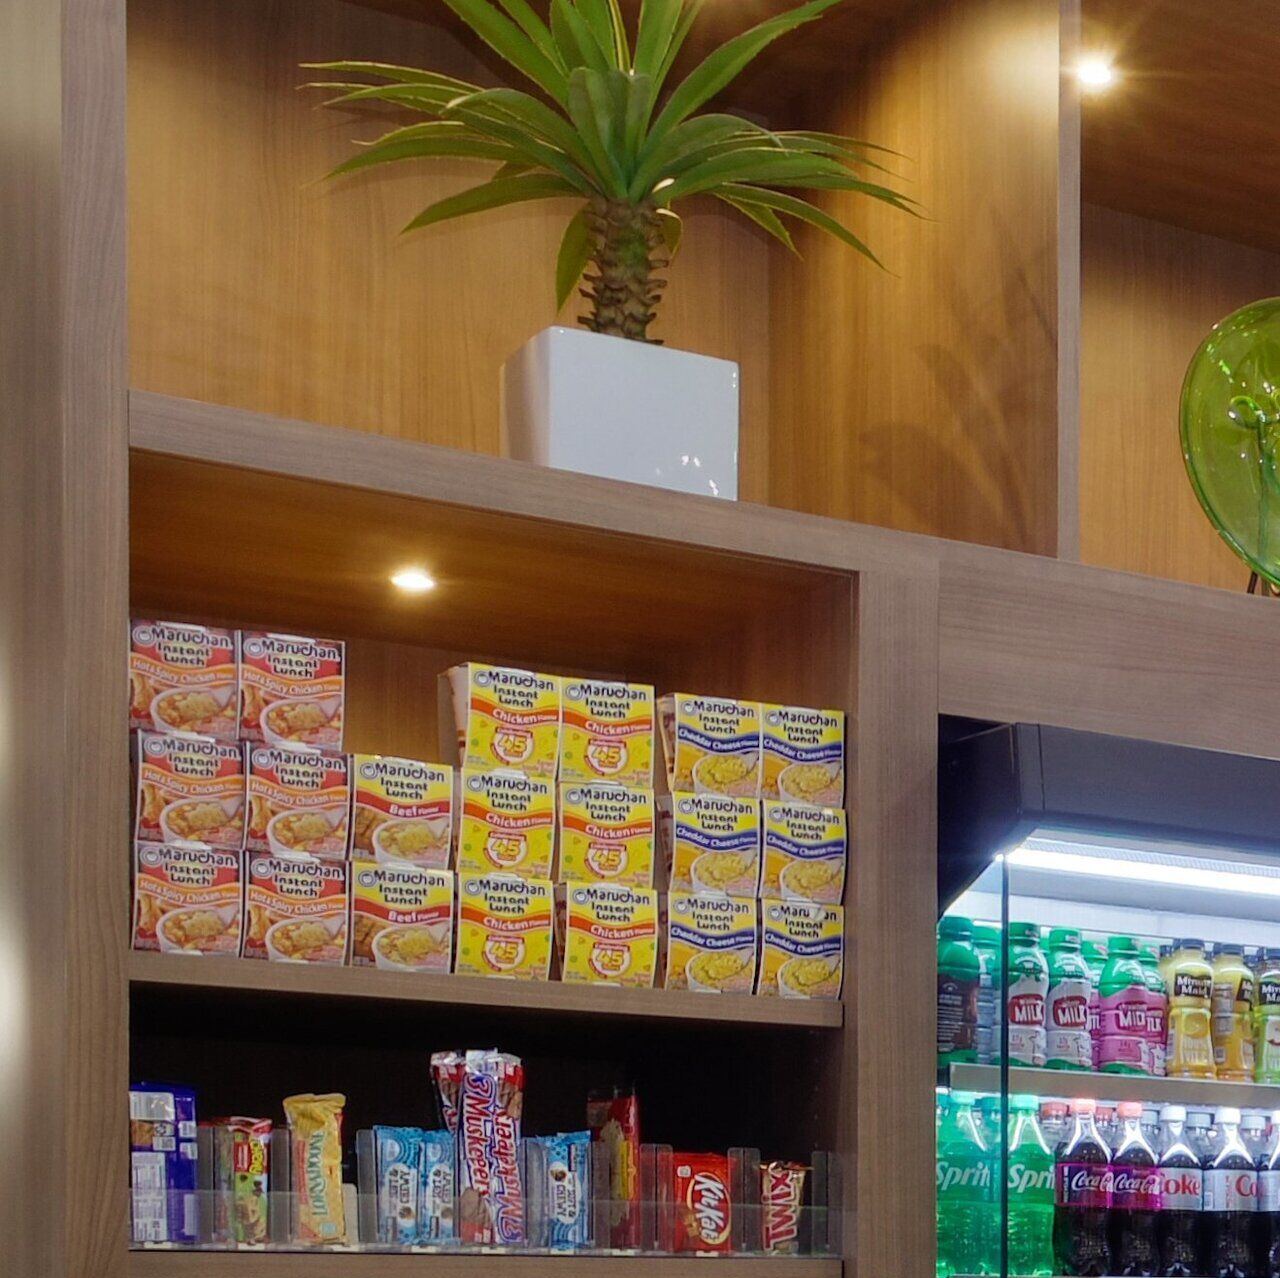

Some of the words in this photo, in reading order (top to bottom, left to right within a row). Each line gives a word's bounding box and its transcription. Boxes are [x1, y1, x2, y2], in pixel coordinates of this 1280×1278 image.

[152, 627, 229, 648] Maruchan
[158, 644, 209, 657] Instant
[262, 640, 337, 659] Maruchan
[164, 653, 205, 666] Lunch
[267, 655, 317, 668] Instant
[274, 665, 312, 678] Lunch
[489, 671, 554, 690] Maruchan
[494, 685, 538, 699] Instant
[581, 684, 646, 700] Maruchan
[499, 696, 533, 708] Lunch
[586, 698, 630, 709] Instant
[591, 709, 625, 718] Lunch
[694, 701, 754, 717] Maruchan
[493, 709, 536, 724] Chicken
[699, 714, 739, 725] Instant
[779, 712, 837, 727] Maruchan
[586, 721, 630, 734] Chicken
[704, 724, 736, 734] Lunch
[784, 723, 823, 735] Instant
[788, 733, 819, 744] Lunch
[162, 739, 237, 758] Maruchan
[169, 754, 219, 768] Instant
[270, 752, 342, 770] Maruchan
[175, 764, 214, 777] Lunch
[276, 765, 324, 778] Instant
[376, 763, 445, 782] Maruchan
[281, 775, 319, 788] Lunch
[381, 777, 428, 790] Instant
[482, 776, 547, 793] Maruchan
[386, 788, 423, 799] Lunch
[487, 789, 531, 802] Instant
[581, 789, 646, 803] Maruchan
[389, 805, 417, 817] Beef
[492, 800, 527, 811] Lunch
[586, 802, 630, 812] Instant
[692, 800, 752, 813] Maruchan
[486, 813, 530, 827] Chicken
[591, 812, 626, 821] Lunch
[697, 812, 737, 822] Instant
[782, 809, 839, 824] Maruchan
[586, 825, 630, 838] Chicken
[702, 821, 733, 829] Lunch
[787, 820, 826, 831] Instant
[792, 830, 822, 840] Lunch
[159, 849, 234, 866] Maruchan
[165, 863, 215, 876] Instant
[269, 861, 341, 879] Maruchan
[171, 874, 211, 885] Lunch
[274, 875, 323, 888] Instant
[374, 870, 444, 886] Maruchan
[280, 885, 317, 896] Lunch
[379, 885, 428, 896] Instant
[479, 880, 545, 895] Maruchan
[385, 895, 422, 905] Lunch
[484, 893, 529, 905] Instant
[587, 890, 649, 904] Maruchan
[490, 904, 525, 914] Lunch
[592, 903, 634, 913] Instant
[687, 899, 749, 913] Maruchan
[389, 911, 417, 922] Beef
[597, 912, 630, 921] Lunch
[693, 912, 733, 922] Instant
[781, 906, 837, 920] Maruan
[484, 918, 528, 929] Chicken
[697, 921, 730, 930] Lunch
[785, 919, 823, 929] Instant
[591, 925, 634, 938] Chicken
[789, 928, 819, 938] Lunch
[1015, 1001, 1043, 1021] MILK
[1058, 1006, 1087, 1024] MILK
[465, 1075, 493, 1096] 3
